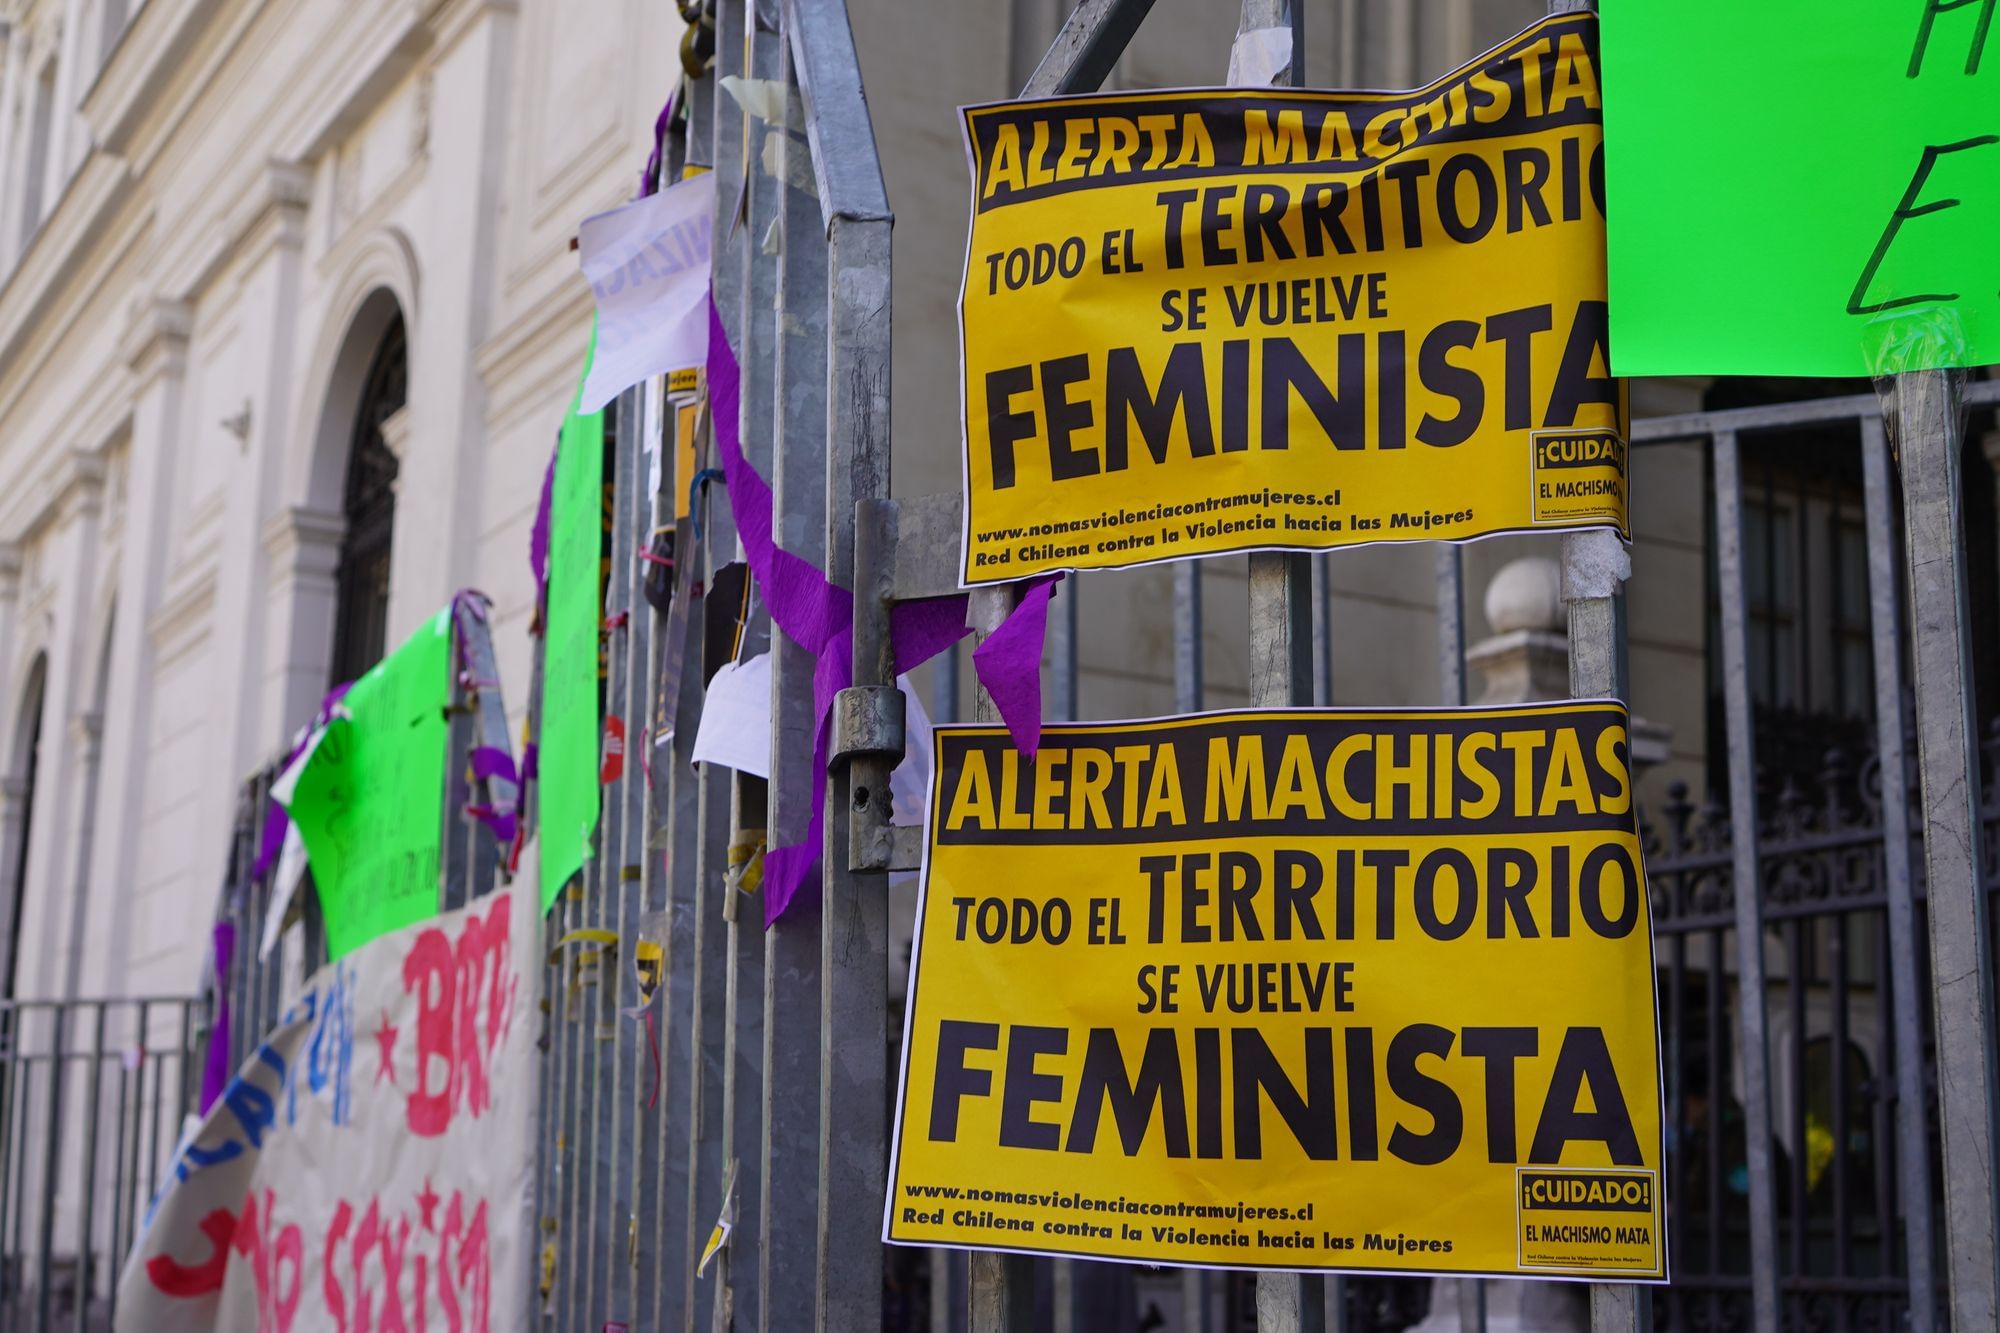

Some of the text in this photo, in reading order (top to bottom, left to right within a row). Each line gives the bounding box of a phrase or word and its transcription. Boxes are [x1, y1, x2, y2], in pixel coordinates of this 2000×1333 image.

[982, 32, 1602, 200] ALERTA MACHISTA
[986, 136, 1607, 296] TODO EL TERRITORI
[1161, 272, 1388, 332] SE VUELVE
[985, 300, 1623, 491] FEMINISTA
[977, 488, 1341, 543] www.nomasviolenciacontramujeres.cl
[1540, 483, 1552, 498] EL
[1555, 480, 1618, 498] MACHISMO
[976, 508, 1474, 566] Red Chilena contra la Violencia hacia las Mujeres
[945, 725, 1631, 830] ALERTA MACHISTAS
[952, 842, 1639, 945] TODO EL TERRITORIO
[1137, 962, 1355, 1014] SE VUELVE
[928, 1020, 1645, 1166] FEMINISTA
[905, 1184, 1313, 1223] www.nomasviolenciacontramujeres.cl
[1524, 1179, 1649, 1209] ¡CUIDADO!
[902, 1208, 1453, 1255] Red Chilena contra la Violencia hacia las Mujeres
[1526, 1225, 1651, 1245] EL MACHISMO MATA
